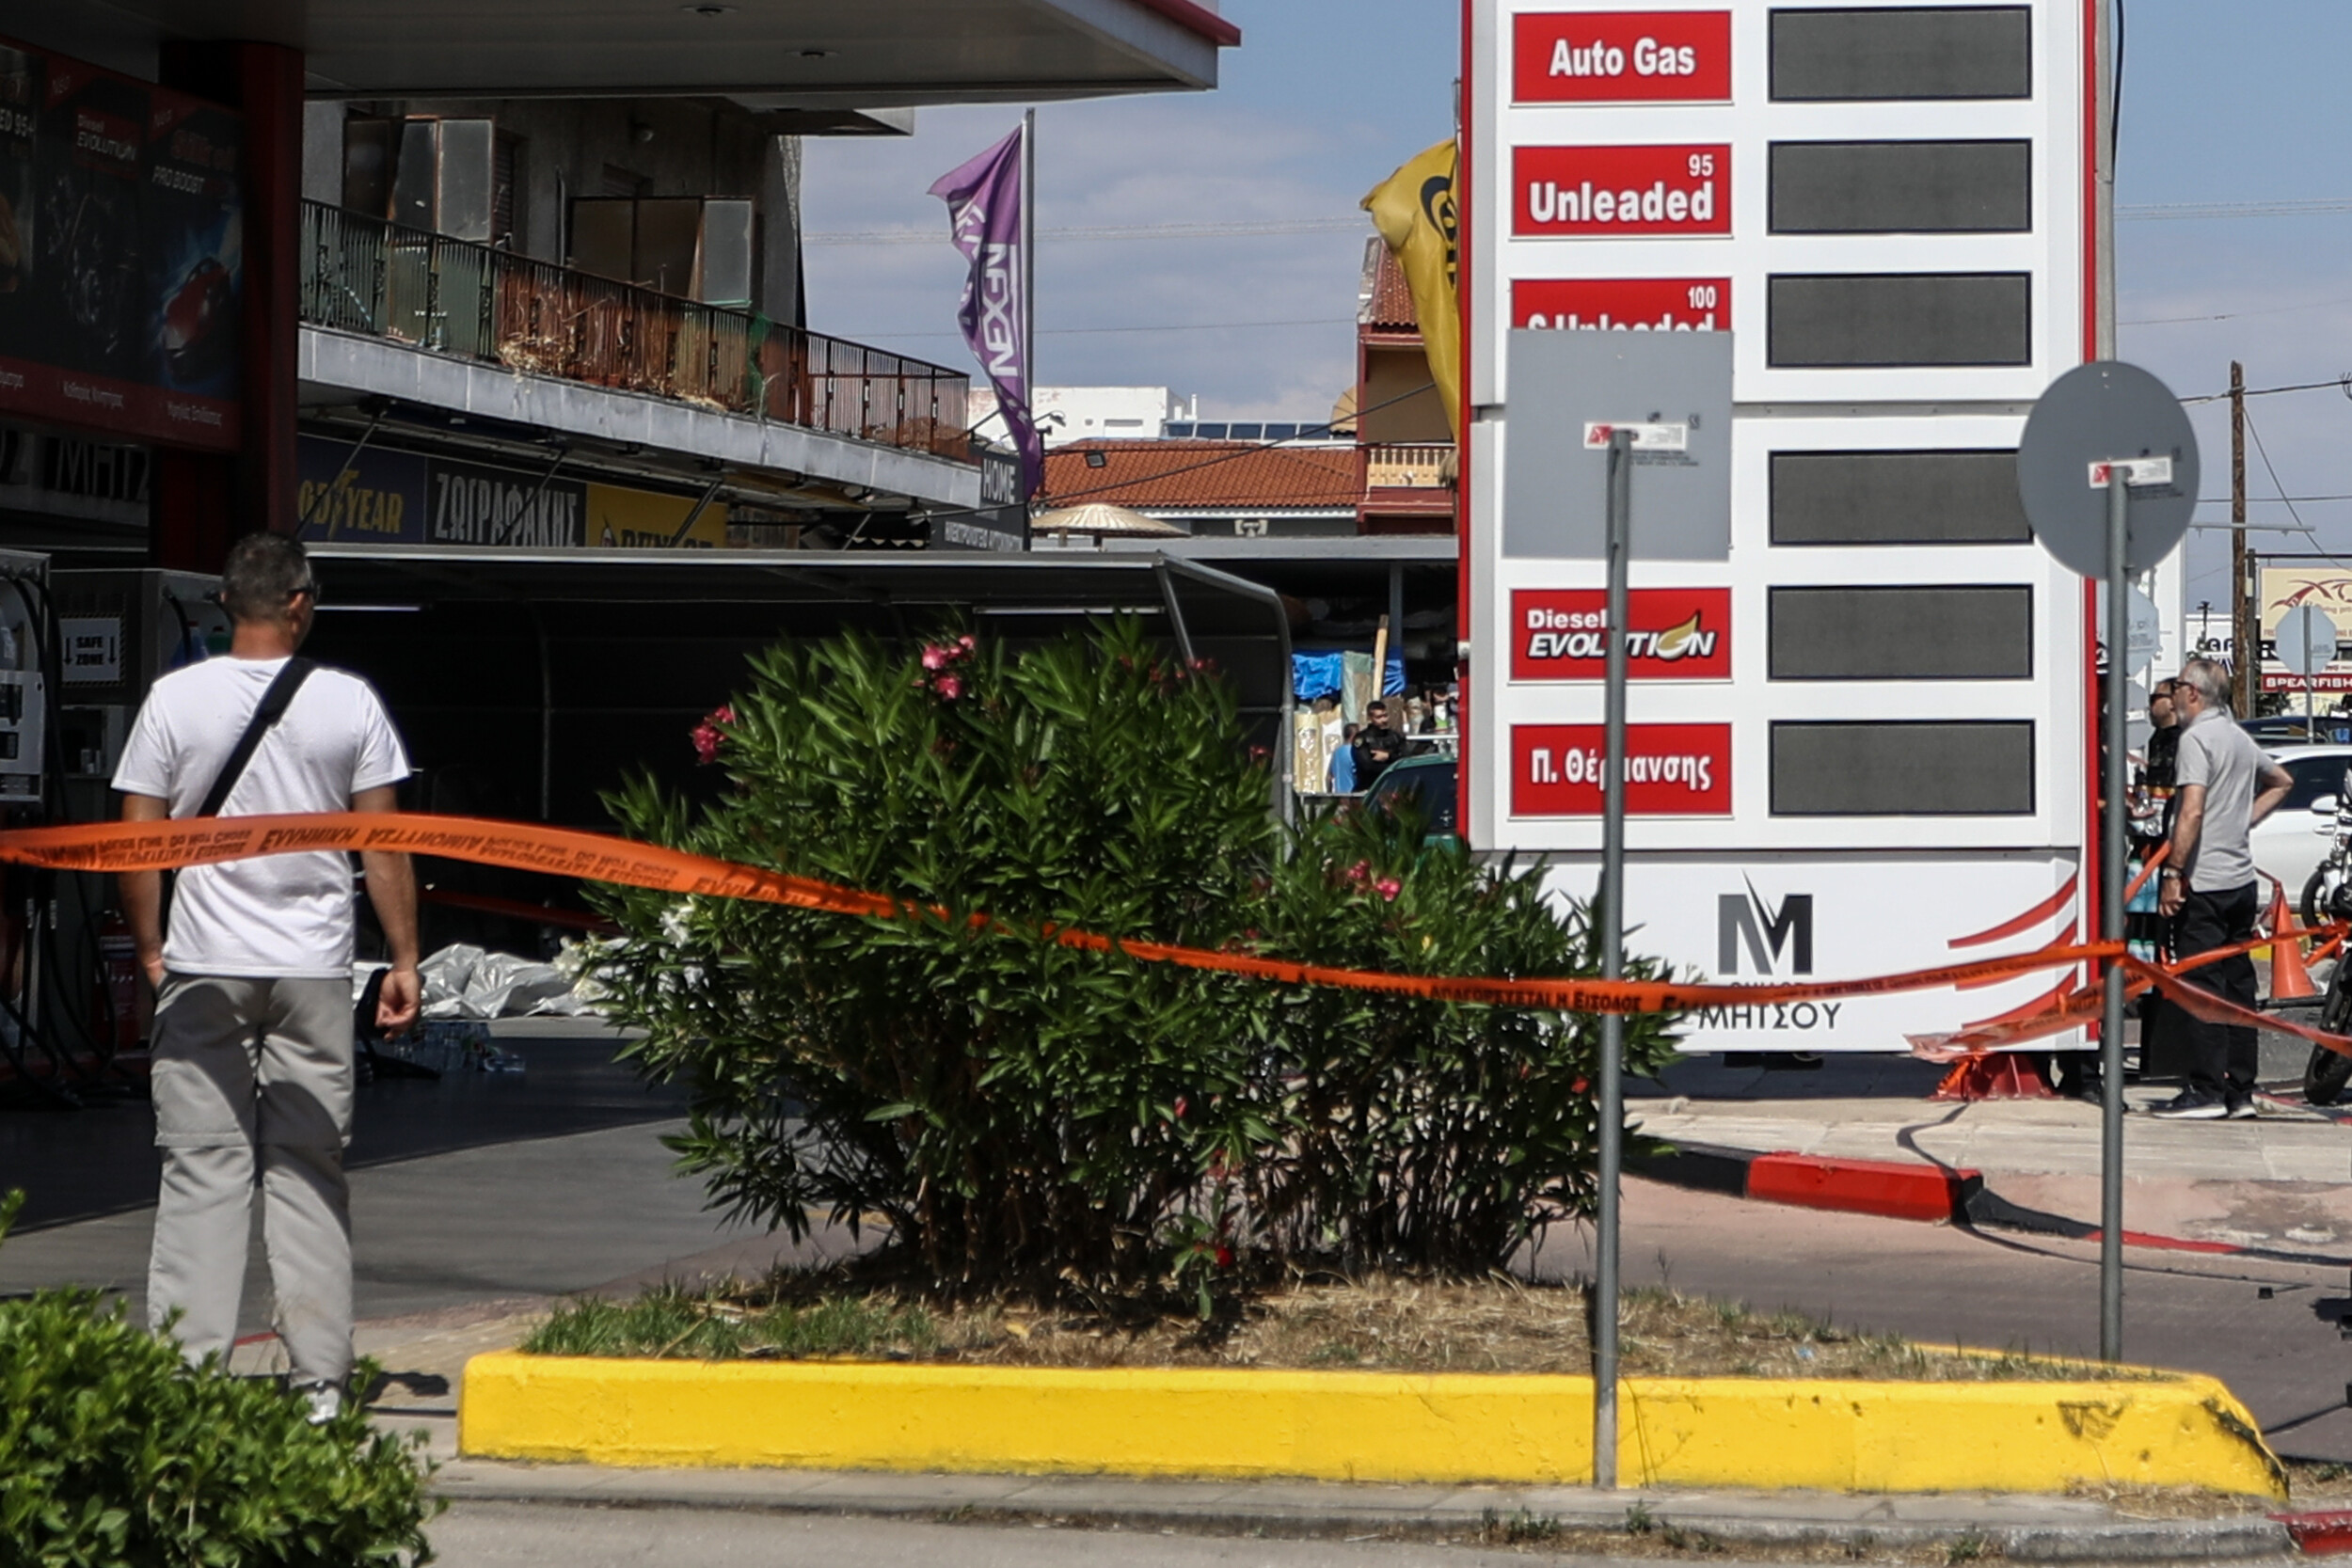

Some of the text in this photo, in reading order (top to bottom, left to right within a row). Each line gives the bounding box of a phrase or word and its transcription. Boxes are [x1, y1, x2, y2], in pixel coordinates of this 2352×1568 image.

[1549, 37, 1696, 77] Auto Gas
[1688, 154, 1714, 178] 95
[1529, 181, 1714, 223] Unleaded
[1688, 285, 1717, 309] 100
[983, 458, 1015, 505] HOME
[1527, 609, 1608, 629] Diesel
[76, 636, 103, 648] SAFE
[1528, 629, 1715, 660] EVOLTION
[1532, 749, 1558, 784] Π.
[1698, 1002, 1842, 1029] ΜΗΤΣΟΥ
